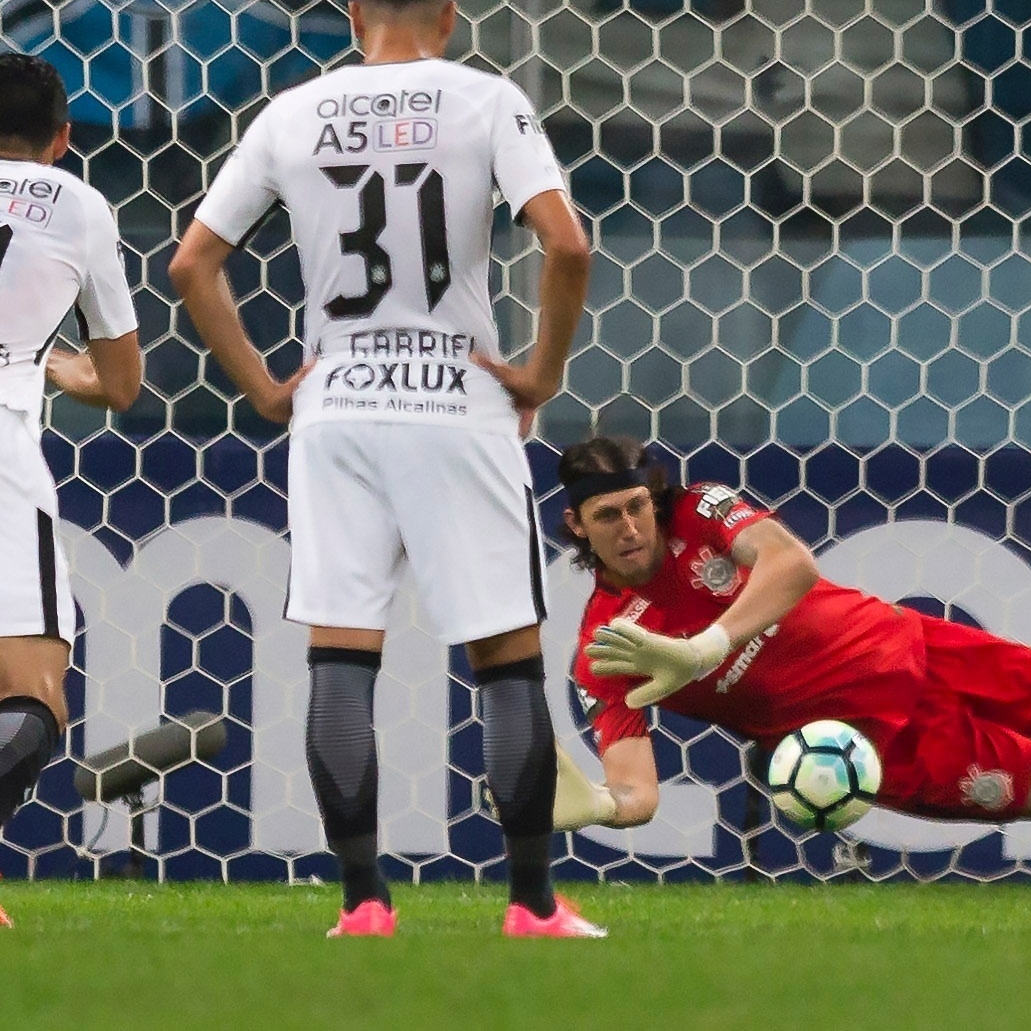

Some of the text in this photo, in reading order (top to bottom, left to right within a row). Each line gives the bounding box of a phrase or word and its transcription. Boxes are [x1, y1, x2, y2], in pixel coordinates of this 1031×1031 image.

[316, 89, 442, 119] alcatel
[312, 120, 433, 155] A5 LED
[8, 200, 47, 223] ED
[318, 162, 451, 321] 31
[325, 363, 468, 396] FOXLUX
[323, 395, 468, 417] Pilhas Alcalinas
